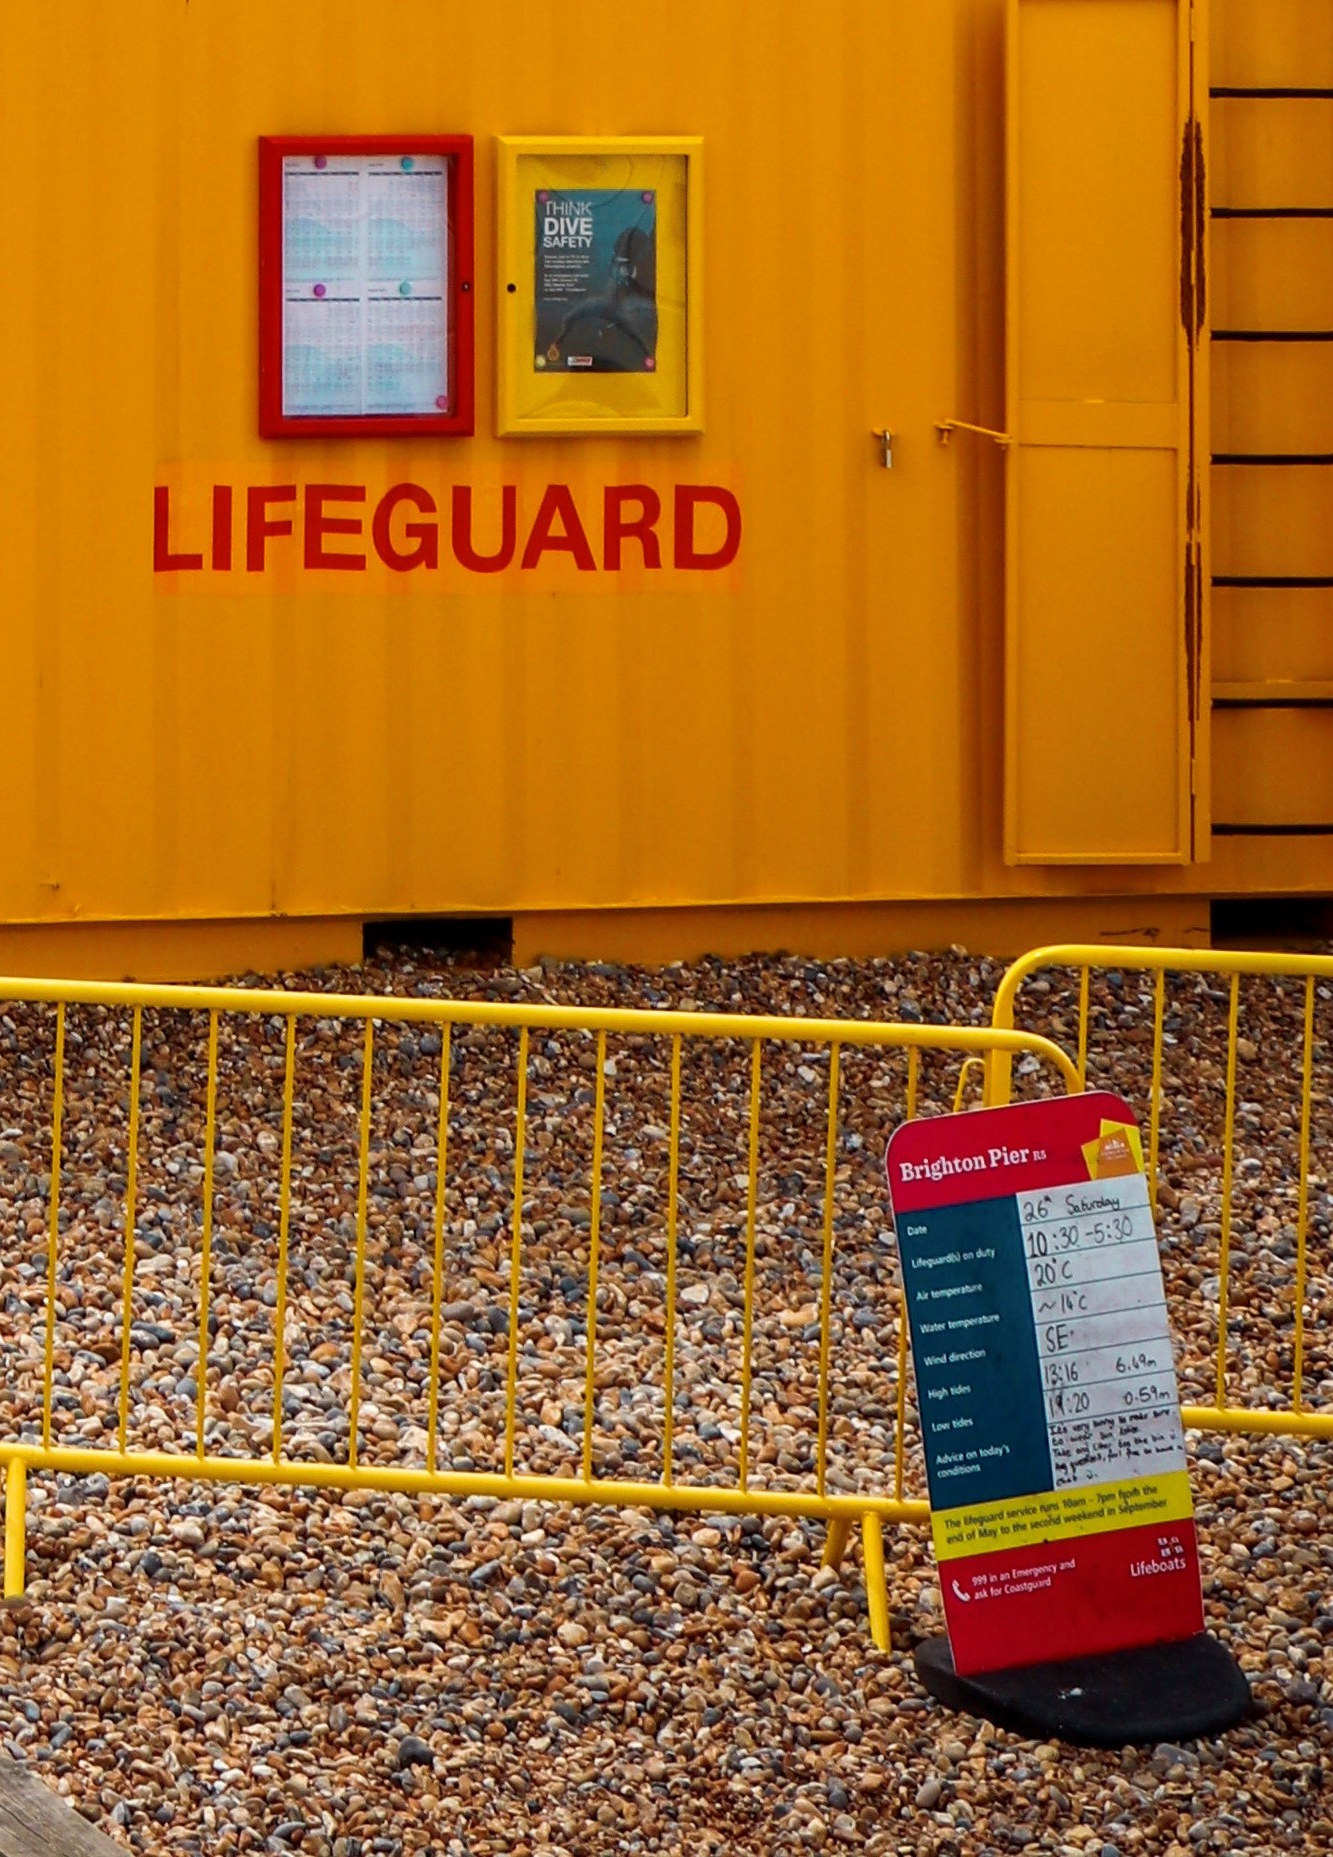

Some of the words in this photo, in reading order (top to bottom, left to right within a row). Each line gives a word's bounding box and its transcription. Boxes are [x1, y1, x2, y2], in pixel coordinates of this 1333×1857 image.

[546, 201, 593, 216] THINK
[544, 217, 593, 236] DIVE
[543, 236, 593, 249] SAFETY
[153, 482, 742, 573] LIFEGUARD
[899, 1156, 987, 1183] Brighton
[987, 1145, 1030, 1169] Pier
[1065, 1194, 1121, 1216] Saturday
[907, 1226, 928, 1236] Date
[911, 1251, 961, 1269] Lifeguard(s)
[962, 1251, 975, 1261] on
[975, 1247, 996, 1259] duty
[916, 1290, 929, 1301] Air
[931, 1284, 983, 1299] temperature
[919, 1322, 946, 1334] Water
[947, 1313, 1001, 1330] temperature
[924, 1352, 948, 1366] Wind
[948, 1348, 987, 1363] direction
[927, 1388, 949, 1400] High
[950, 1385, 972, 1396] tides
[931, 1421, 951, 1432] Low
[952, 1417, 974, 1429] tides
[936, 1451, 964, 1465] Advice
[965, 1450, 977, 1461] on
[979, 1444, 1011, 1457] today's
[937, 1464, 982, 1479] conditions
[944, 1519, 962, 1530] The
[963, 1510, 1005, 1527] lifeguard
[1006, 1505, 1037, 1519] service
[1039, 1502, 1060, 1514] runs
[1062, 1498, 1087, 1509] 10am
[1096, 1492, 1116, 1505] 7pm
[1142, 1485, 1158, 1496] the
[946, 1533, 964, 1545] end
[965, 1530, 977, 1541] of
[978, 1527, 999, 1539] May
[999, 1525, 1011, 1535] to
[1011, 1522, 1028, 1533] the
[1029, 1515, 1061, 1529] second
[1062, 1507, 1106, 1524] weekend
[1106, 1507, 1116, 1516] in
[1118, 1499, 1167, 1515] September
[971, 1574, 988, 1587] 999
[988, 1572, 998, 1583] in
[999, 1572, 1011, 1582] an
[1012, 1563, 1057, 1580] Emergency
[1059, 1557, 1076, 1570] and
[1130, 1557, 1187, 1577] Lifeboats
[974, 1588, 989, 1600] ask
[990, 1586, 1003, 1597] for
[1004, 1576, 1052, 1594] Coastguard
